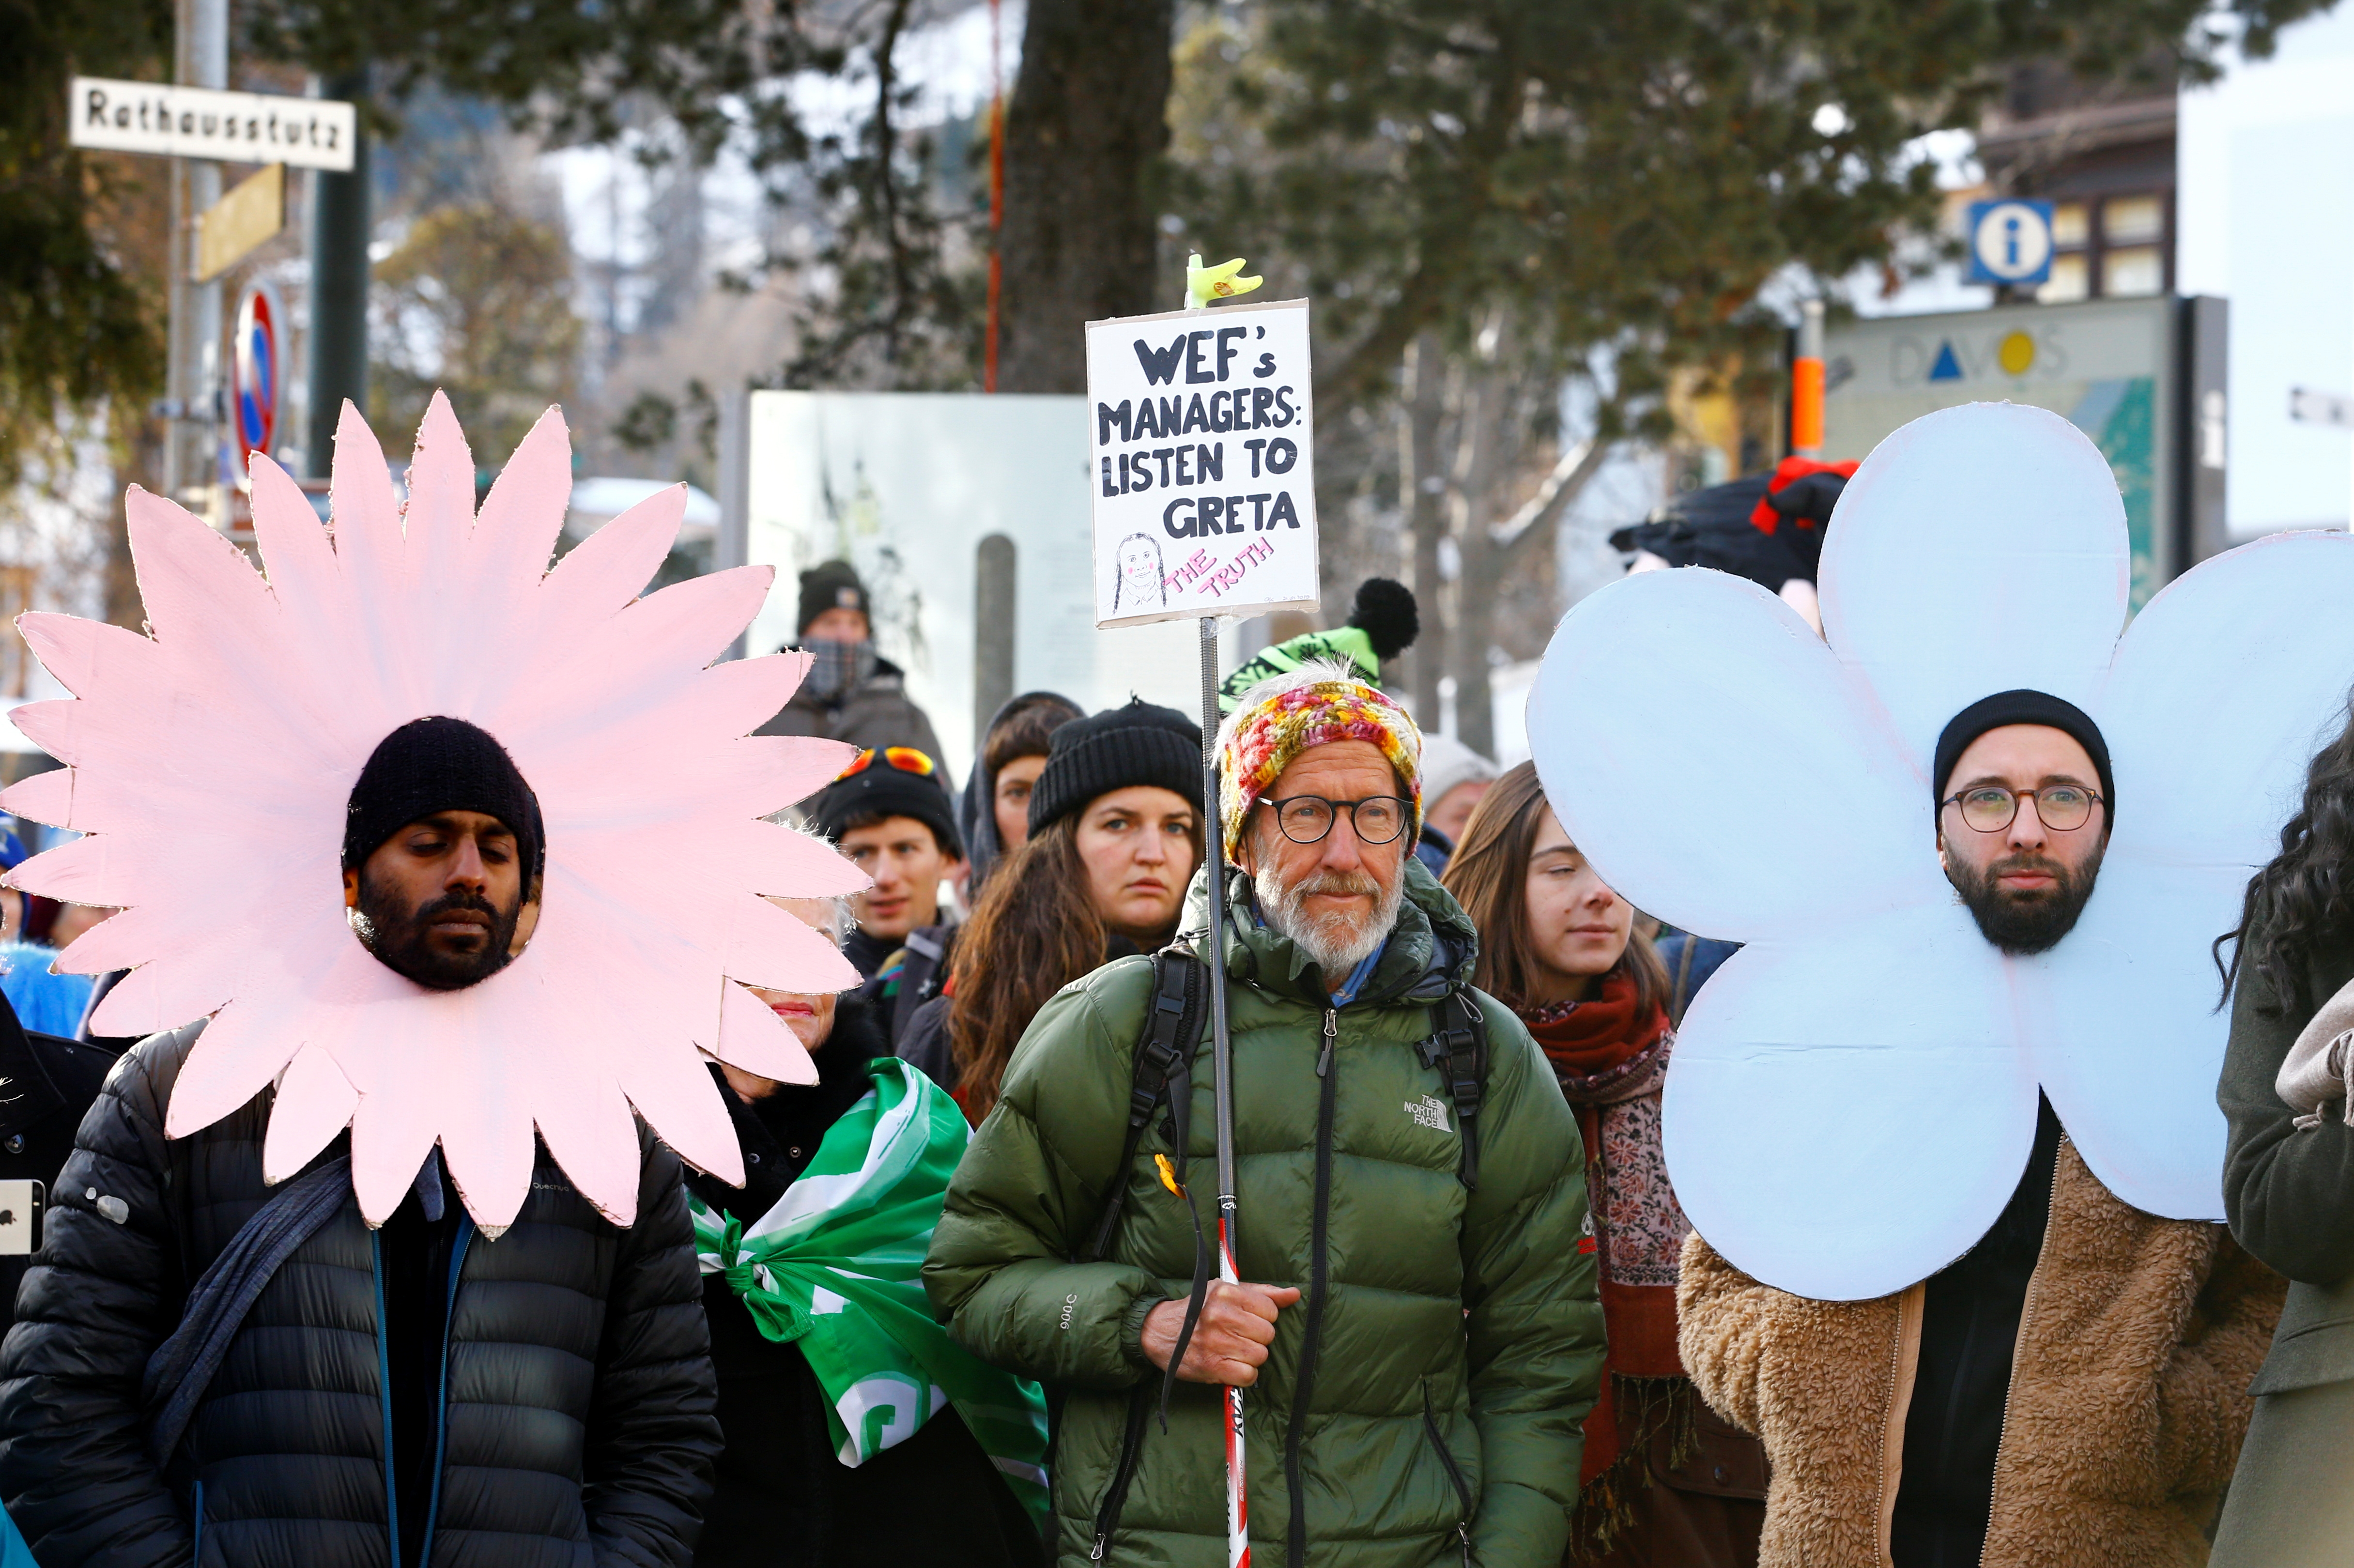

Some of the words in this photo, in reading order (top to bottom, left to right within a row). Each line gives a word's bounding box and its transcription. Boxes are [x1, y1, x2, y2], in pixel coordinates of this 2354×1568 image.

[87, 89, 338, 149] Rathausstutz
[1133, 326, 1277, 385] WEF's
[1098, 386, 1302, 446] MANAGERS:
[1102, 442, 1223, 497] LISTEN
[1244, 437, 1298, 478] TO
[1163, 491, 1301, 538] GRETA
[1163, 548, 1217, 593] THE
[1197, 536, 1275, 598] TRUTH
[1404, 1101, 1437, 1119] NORTH
[1414, 1114, 1438, 1128] FACE
[1421, 1094, 1437, 1108] THE
[533, 1182, 569, 1191] Quechua
[1060, 1294, 1077, 1329] 900C
